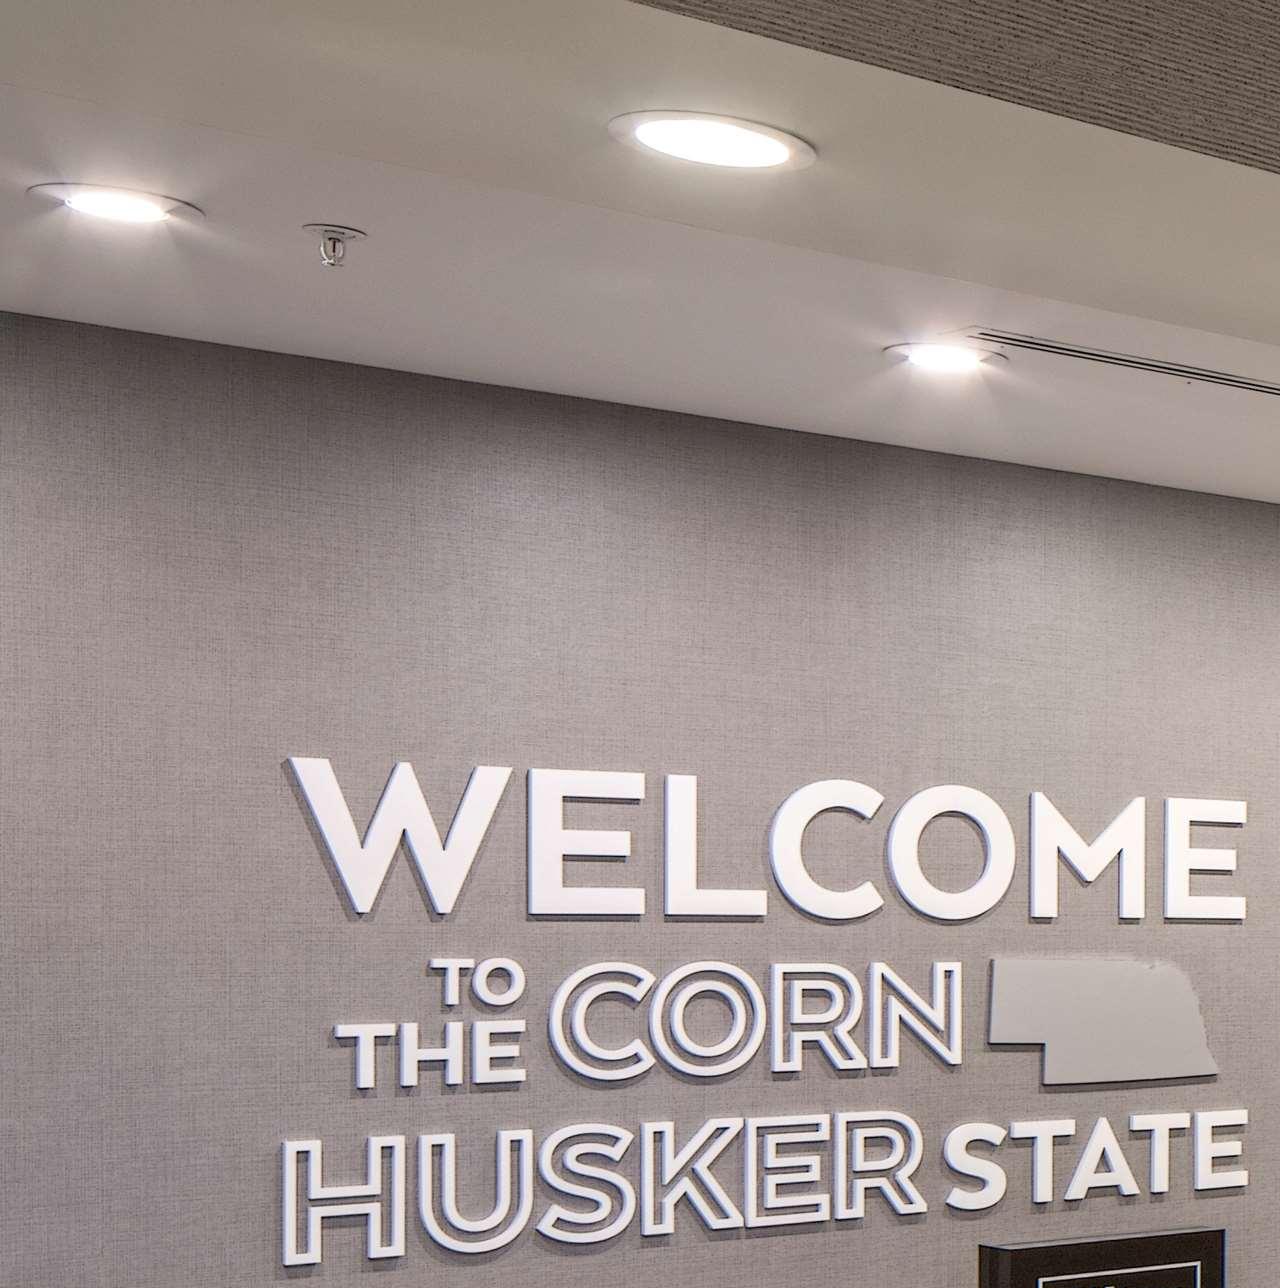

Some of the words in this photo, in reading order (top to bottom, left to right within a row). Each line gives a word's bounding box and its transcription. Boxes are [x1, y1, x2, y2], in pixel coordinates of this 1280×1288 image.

[287, 756, 1248, 920] WELCOME
[335, 1019, 526, 1088] THE
[548, 960, 963, 1082] CORN
[430, 958, 525, 1006] TO
[283, 1110, 928, 1266] HUSKER
[944, 1109, 1249, 1211] STATE
